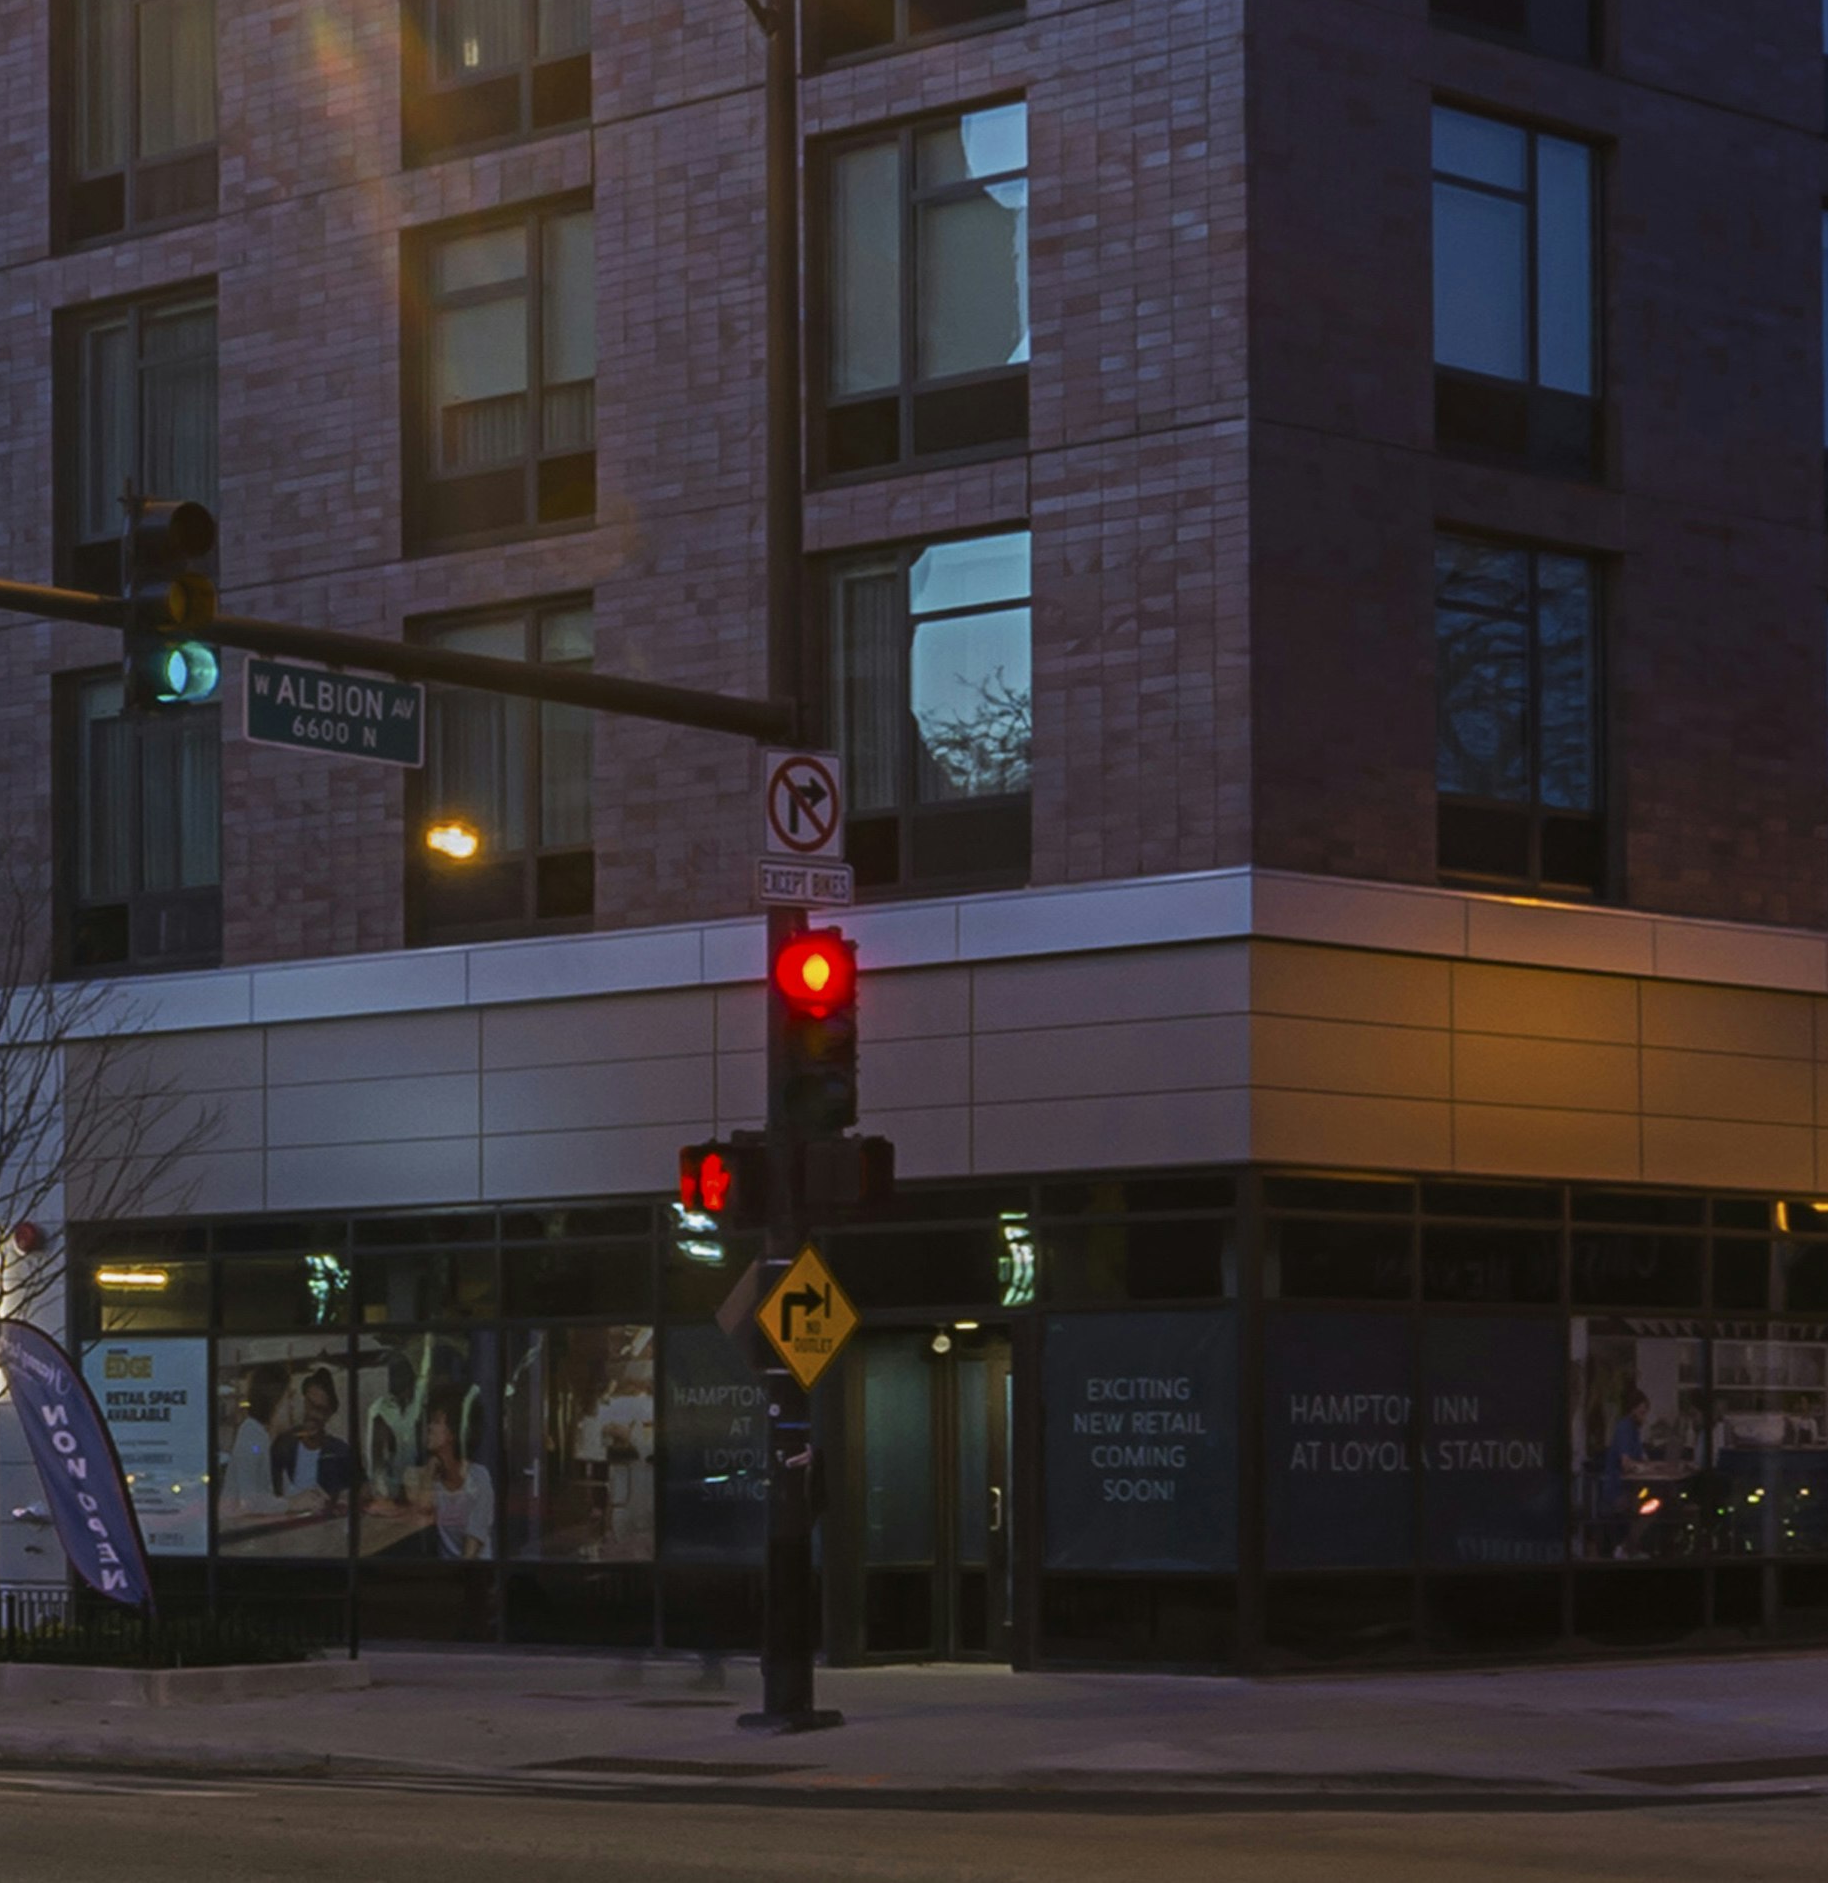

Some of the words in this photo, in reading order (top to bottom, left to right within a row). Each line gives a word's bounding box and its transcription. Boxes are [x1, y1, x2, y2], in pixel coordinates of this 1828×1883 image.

[253, 673, 271, 696] W
[276, 674, 383, 721] ALBION
[390, 697, 415, 720] AV
[292, 715, 350, 744] 6600
[362, 726, 377, 749] N
[763, 869, 806, 894] EXCEPT
[104, 1356, 152, 1379] EDGE
[106, 1391, 145, 1406] RETAIL
[148, 1390, 187, 1406] SPACE
[1086, 1377, 1191, 1402] EXCITING
[107, 1407, 170, 1423] AVAILABLE
[1072, 1412, 1125, 1434] NEW
[1131, 1411, 1207, 1435] RETAIL
[1431, 1396, 1479, 1426] INN
[728, 1416, 753, 1438] AT
[703, 1447, 768, 1471] LOYOL
[1090, 1445, 1187, 1468] COMING
[1290, 1441, 1322, 1471] AT
[1435, 1440, 1541, 1472] STATION
[1103, 1478, 1177, 1503] SOON!
